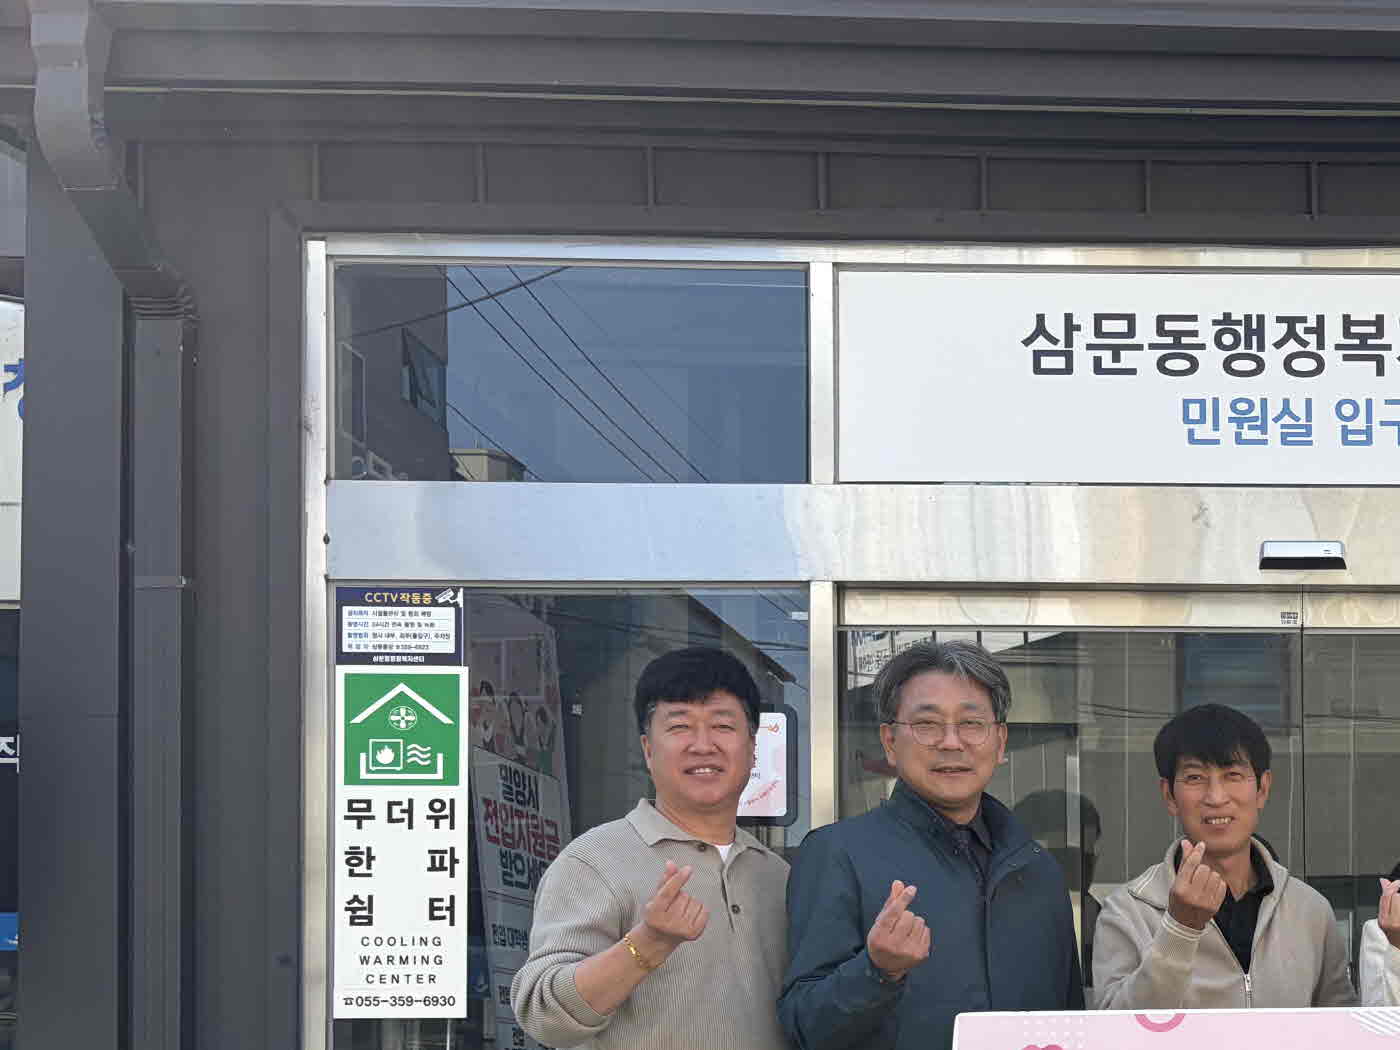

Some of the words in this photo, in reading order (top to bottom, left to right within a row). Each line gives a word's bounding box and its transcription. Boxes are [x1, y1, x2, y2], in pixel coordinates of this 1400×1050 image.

[1181, 397, 1314, 446] 민원실
[365, 592, 432, 604] CCTV작동중
[343, 797, 456, 831] 무더위
[344, 846, 460, 879] 한파
[344, 895, 456, 927] 쉼터
[361, 936, 442, 948] COOLING
[359, 955, 444, 966] WARMING
[366, 974, 438, 985] CENTER
